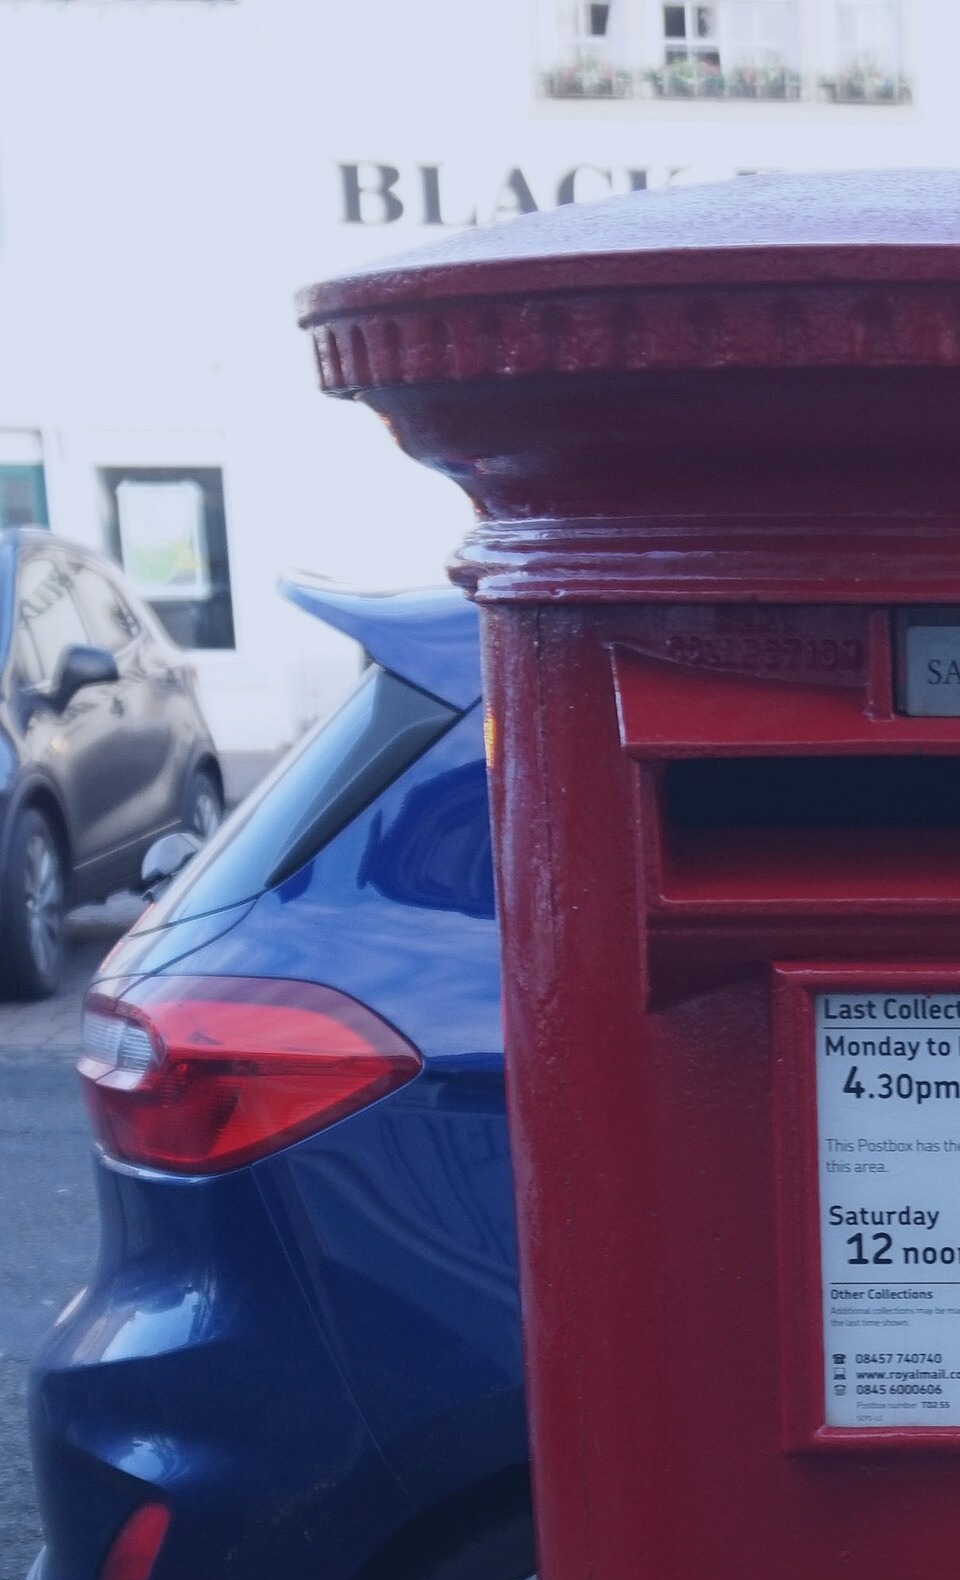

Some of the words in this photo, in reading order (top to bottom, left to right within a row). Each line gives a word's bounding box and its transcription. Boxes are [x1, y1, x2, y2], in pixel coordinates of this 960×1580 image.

[823, 998, 877, 1020] Last
[825, 1036, 920, 1060] Monday
[927, 1038, 950, 1057] to
[843, 1066, 960, 1105] 4.30pm
[827, 1138, 854, 1152] This
[858, 1138, 913, 1153] Postbox
[916, 1139, 940, 1152] has
[826, 1161, 851, 1173] this
[854, 1163, 888, 1173] area.
[829, 1206, 940, 1229] Saturday
[847, 1232, 893, 1265] 12
[830, 1289, 865, 1300] Other
[867, 1289, 933, 1300] Collections
[830, 1318, 844, 1327] the
[846, 1318, 860, 1327] last
[862, 1318, 880, 1327] time
[855, 1353, 893, 1364] 08457
[895, 1353, 942, 1364] 740740
[856, 1385, 887, 1395] 0845
